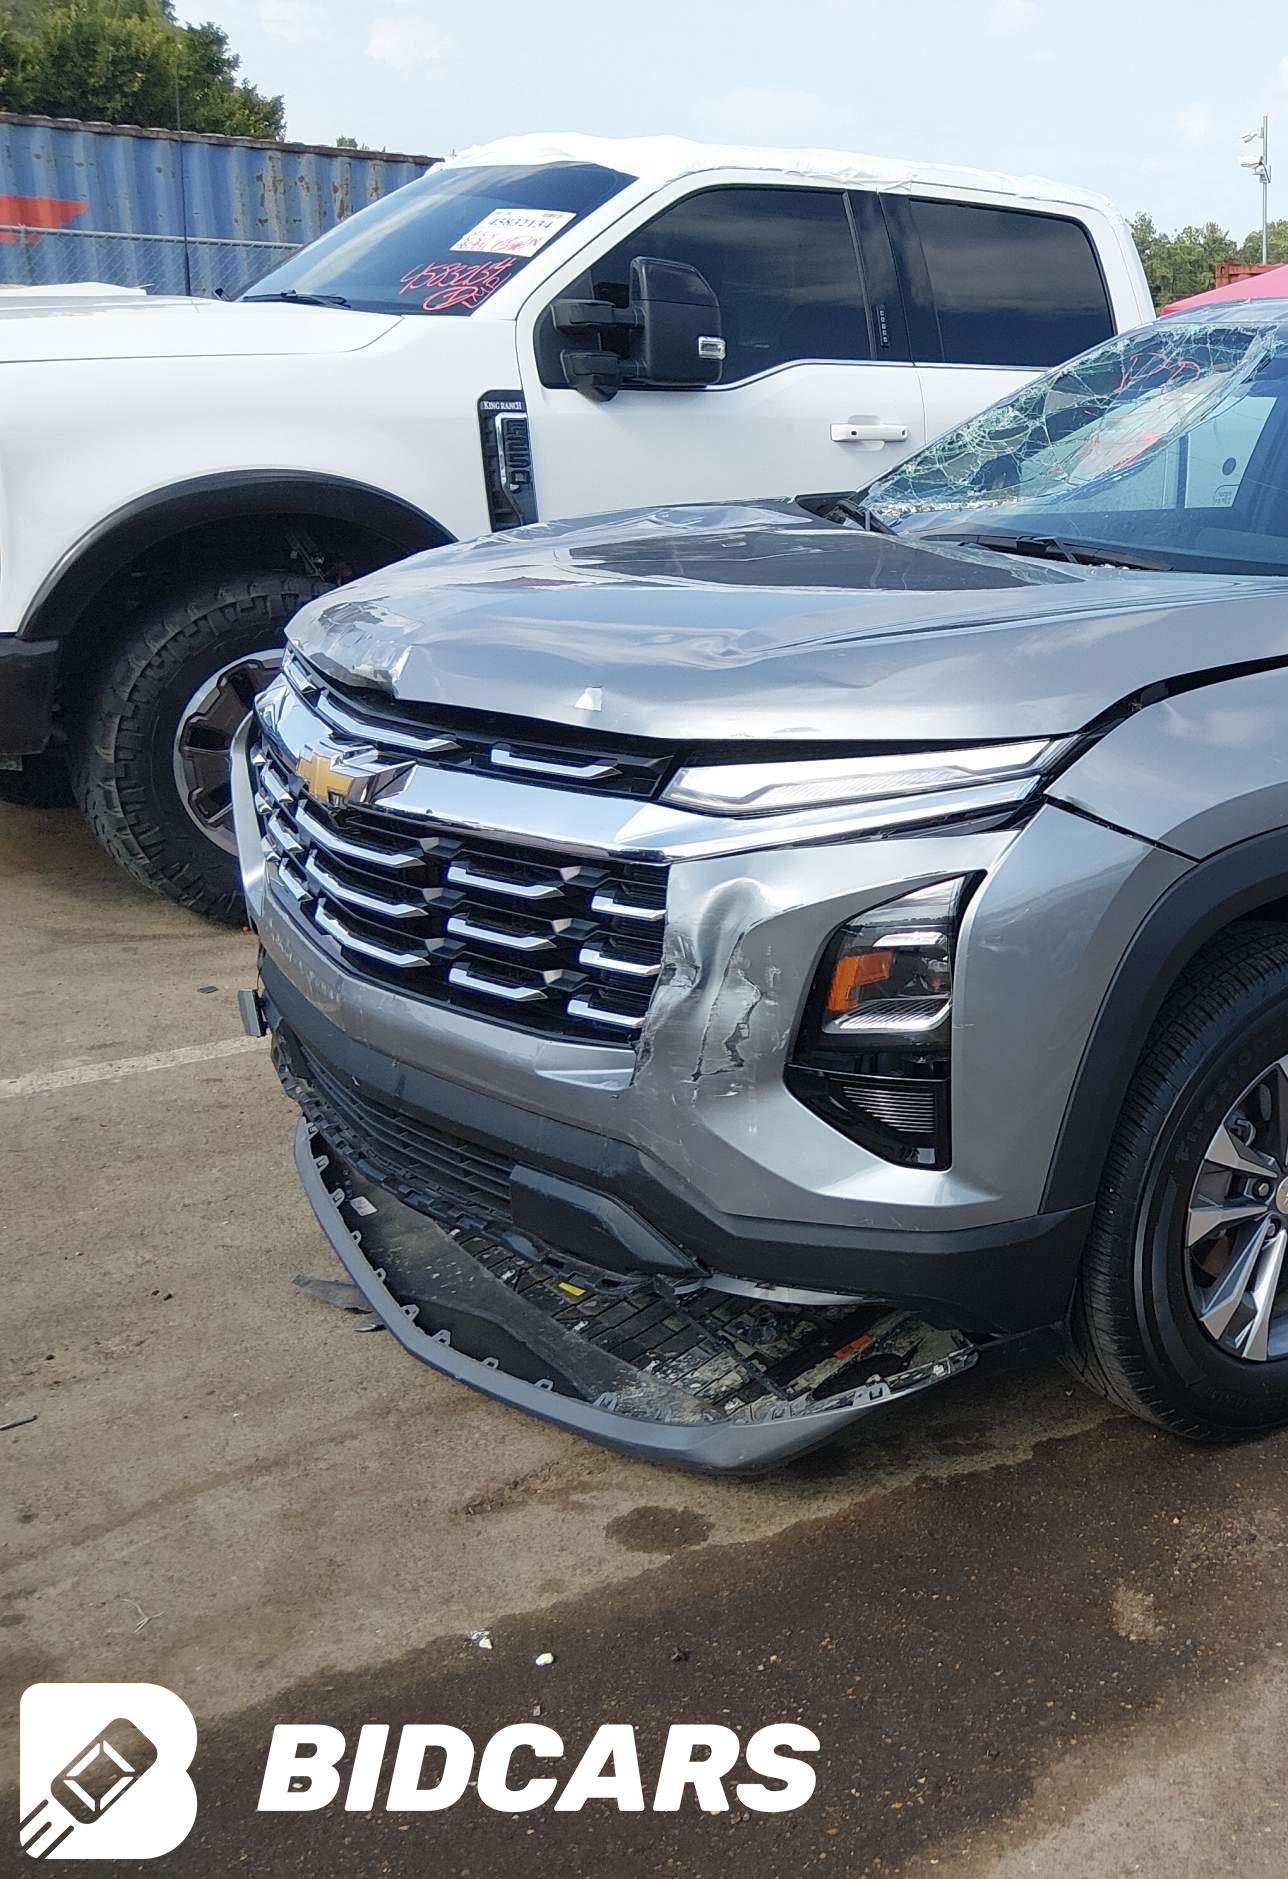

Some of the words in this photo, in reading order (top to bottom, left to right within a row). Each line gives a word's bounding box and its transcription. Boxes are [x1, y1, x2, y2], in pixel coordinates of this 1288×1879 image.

[488, 216, 553, 229] 45832134
[484, 401, 500, 410] KING
[501, 401, 523, 410] RANCH
